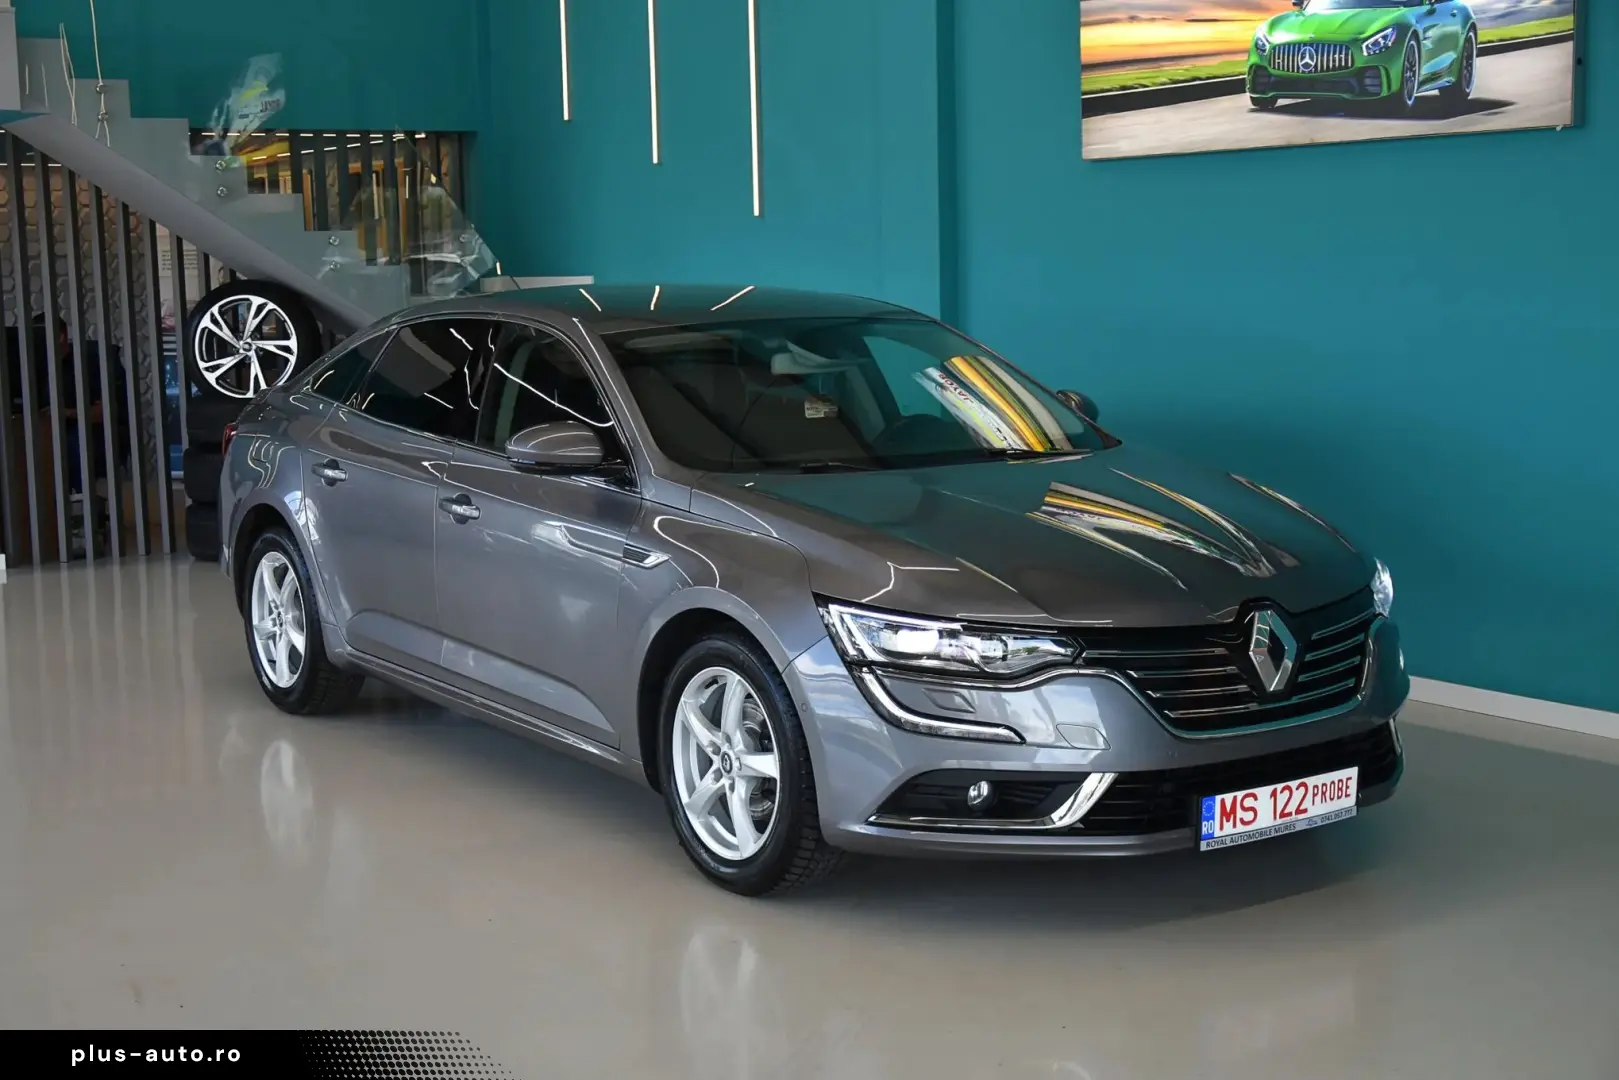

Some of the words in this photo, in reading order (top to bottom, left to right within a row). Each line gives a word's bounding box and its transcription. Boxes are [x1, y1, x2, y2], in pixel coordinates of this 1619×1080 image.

[1219, 792, 1258, 831] MS
[1270, 781, 1309, 820] 122
[1312, 777, 1352, 806] PROBE
[1202, 820, 1214, 835] RO
[1206, 837, 1228, 849] ROYAL
[1229, 828, 1273, 845] AUTOMOBILE
